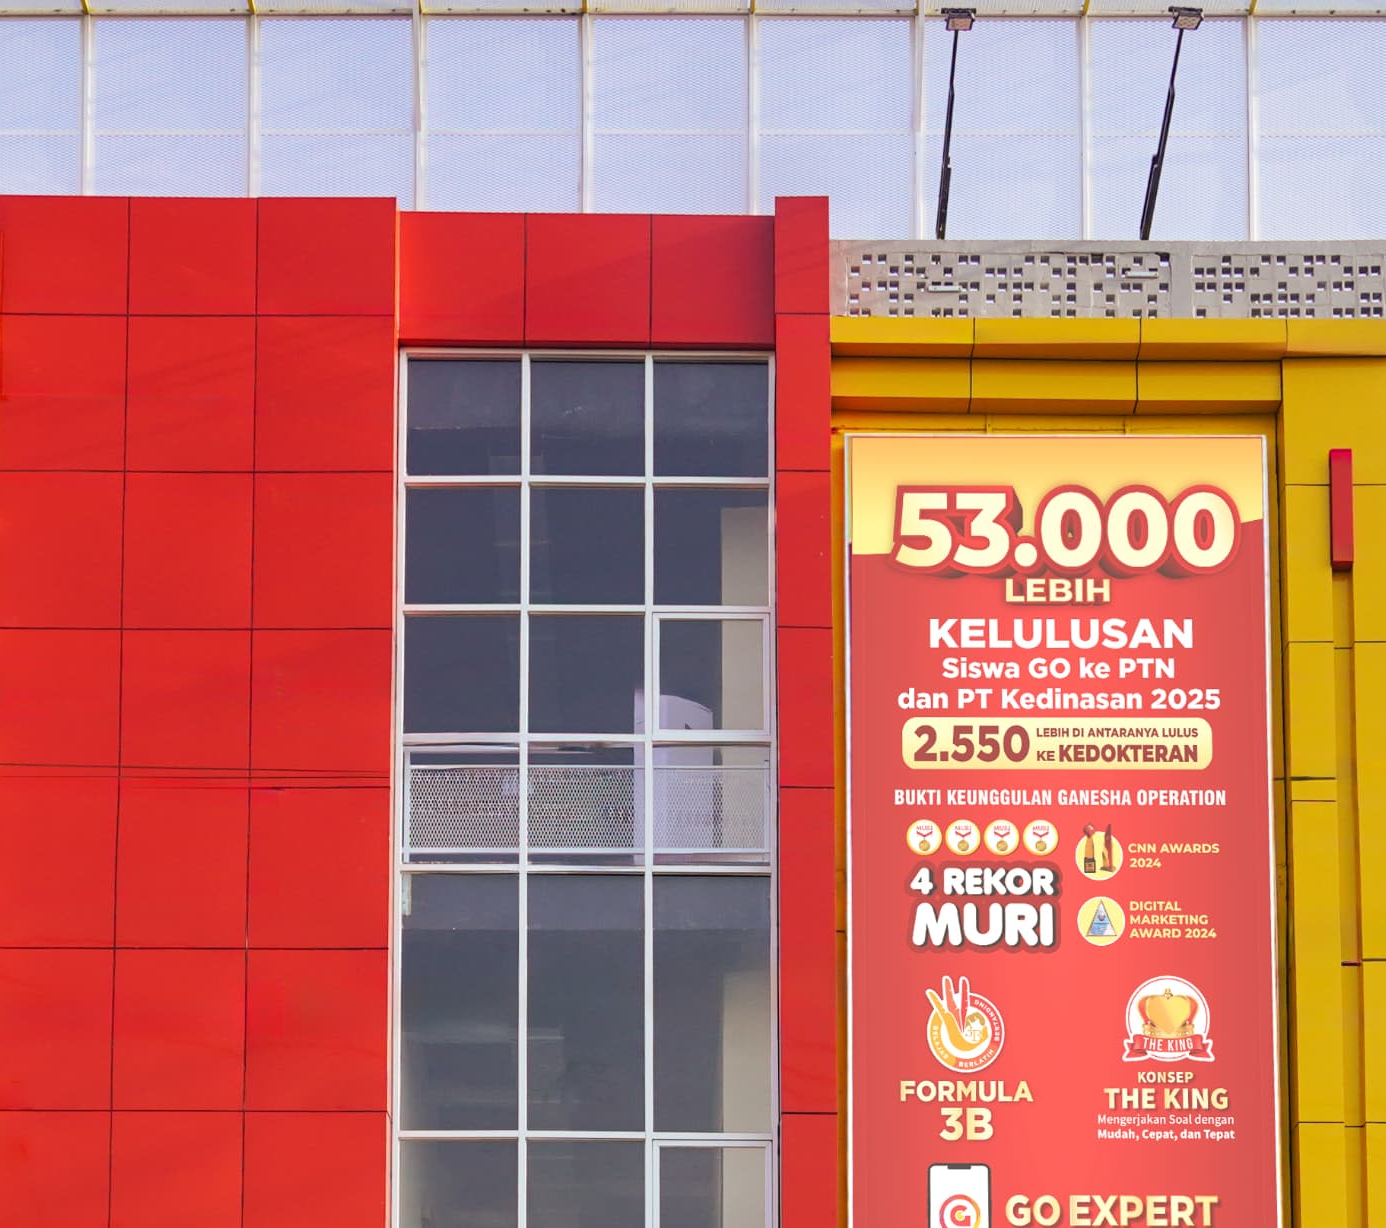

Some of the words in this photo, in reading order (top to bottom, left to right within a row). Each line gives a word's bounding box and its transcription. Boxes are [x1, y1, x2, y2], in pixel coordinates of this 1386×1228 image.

[893, 488, 1238, 571] 53.000
[1006, 578, 1110, 603] LEBIH
[929, 618, 1193, 649] KELULUSAN
[942, 657, 1020, 679] Siswa
[1028, 658, 1071, 679] GO
[1079, 657, 1111, 679] ke
[1119, 658, 1175, 679] PTN
[898, 688, 949, 710] dan
[957, 689, 994, 710] PT
[1001, 688, 1143, 711] Kedinasan
[1151, 688, 1221, 710] 2025
[1036, 727, 1070, 738] LEBIH
[1072, 727, 1086, 738] DI
[1087, 727, 1160, 738] ANTARANYA
[1162, 727, 1199, 738] LULUS
[913, 724, 1031, 763] 2.550
[1036, 750, 1055, 762] KE
[1059, 744, 1198, 763] KEDOKTERAN
[894, 789, 942, 806] BUKTI
[947, 789, 1053, 806] KEUNGGULAN
[1057, 789, 1132, 806] GANESHA
[1136, 789, 1226, 806] OPERATION
[1128, 843, 1158, 854] CNN
[1160, 843, 1220, 854] AWARDS
[1129, 857, 1162, 868] 2024
[909, 866, 934, 896] 4
[943, 866, 1055, 896] REKOR
[1129, 901, 1181, 912] DIGITAL
[911, 902, 1054, 947] MURI
[1129, 914, 1209, 926] MARKETING
[1129, 928, 1181, 939] AWARD
[1185, 928, 1217, 940] 2024
[1142, 1037, 1163, 1051] THE
[1167, 1038, 1194, 1052] KING
[1137, 1071, 1194, 1084] KONSEP
[900, 1080, 1034, 1103] FORMULA
[1103, 1088, 1156, 1109] THE
[1163, 1088, 1230, 1110] KING
[939, 1107, 995, 1141] 3B
[1097, 1114, 1166, 1128] Mengerjakan
[1168, 1114, 1192, 1125] Soal
[1194, 1114, 1235, 1128] dengan
[1097, 1129, 1140, 1141] Mudah,
[1141, 1129, 1178, 1142] Cepat,
[1180, 1129, 1201, 1139] dan
[1204, 1129, 1236, 1142] Tepat
[1005, 1194, 1061, 1227] GO
[1068, 1194, 1220, 1228] EXPERT
